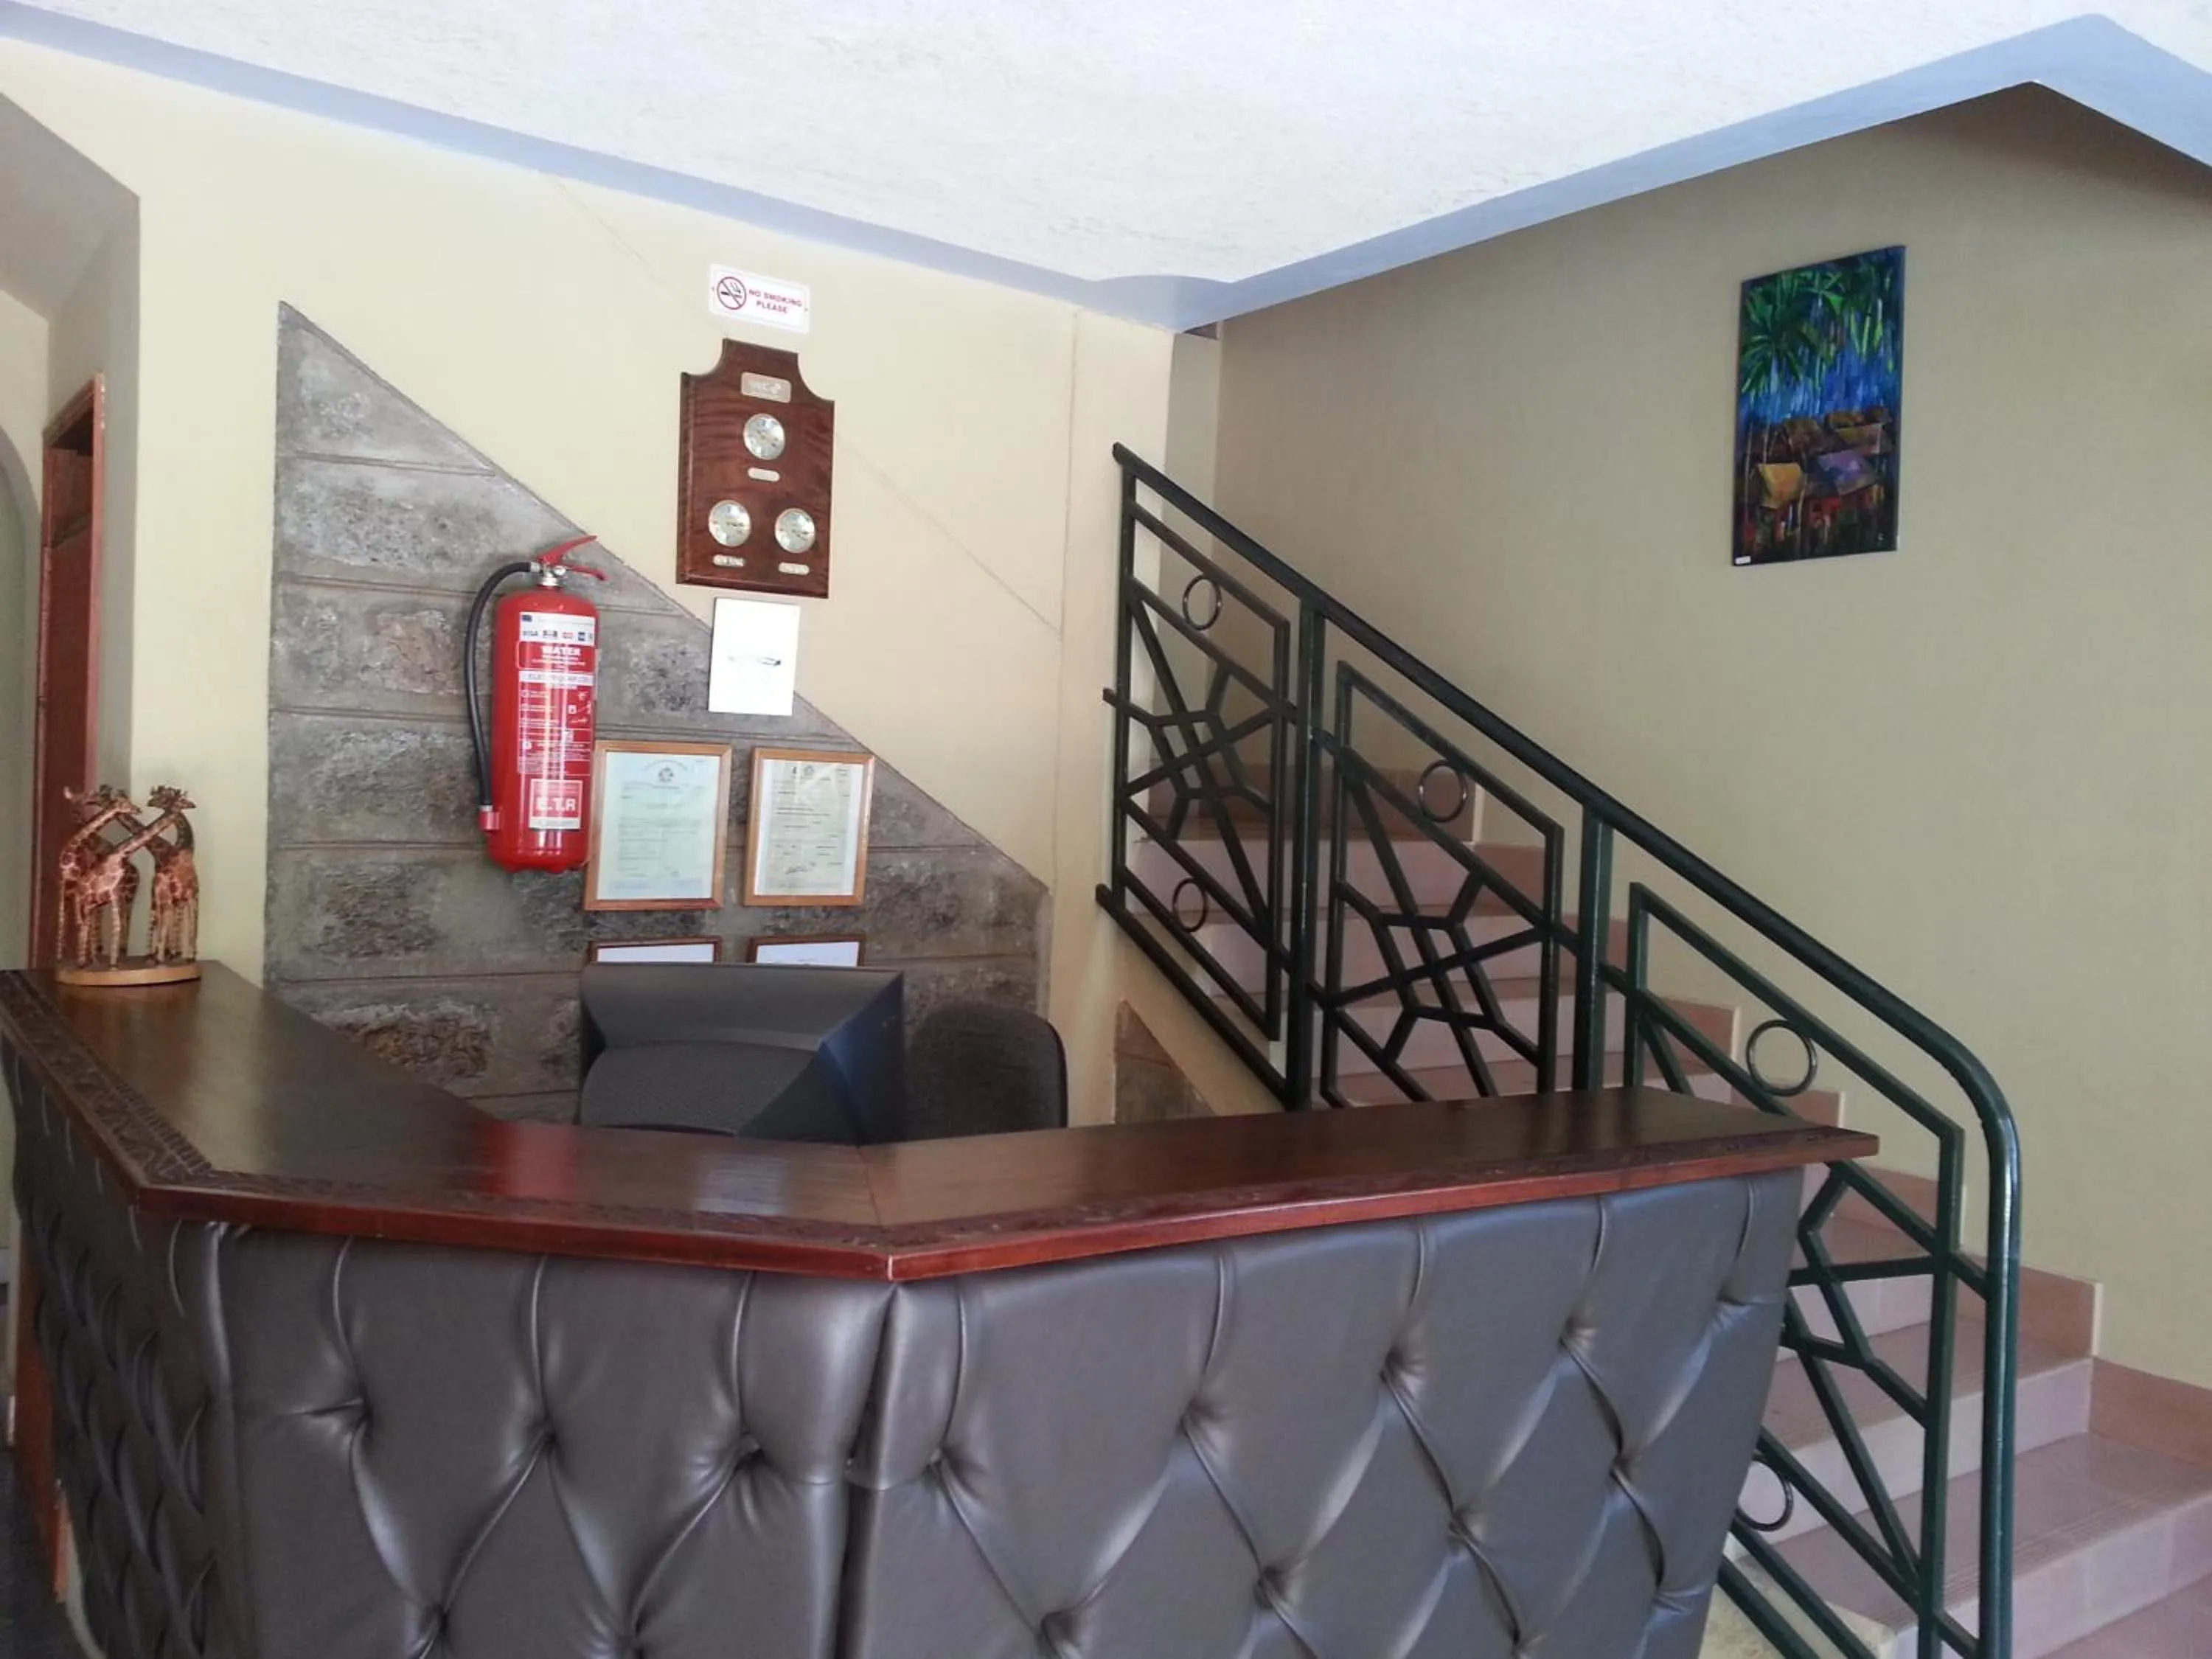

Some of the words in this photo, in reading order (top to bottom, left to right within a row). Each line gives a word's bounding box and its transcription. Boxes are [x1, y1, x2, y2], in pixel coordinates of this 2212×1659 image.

[748, 288, 761, 297] NO
[763, 291, 802, 307] SMOKING
[756, 299, 787, 314] PLEASE
[541, 645, 580, 656] WATER
